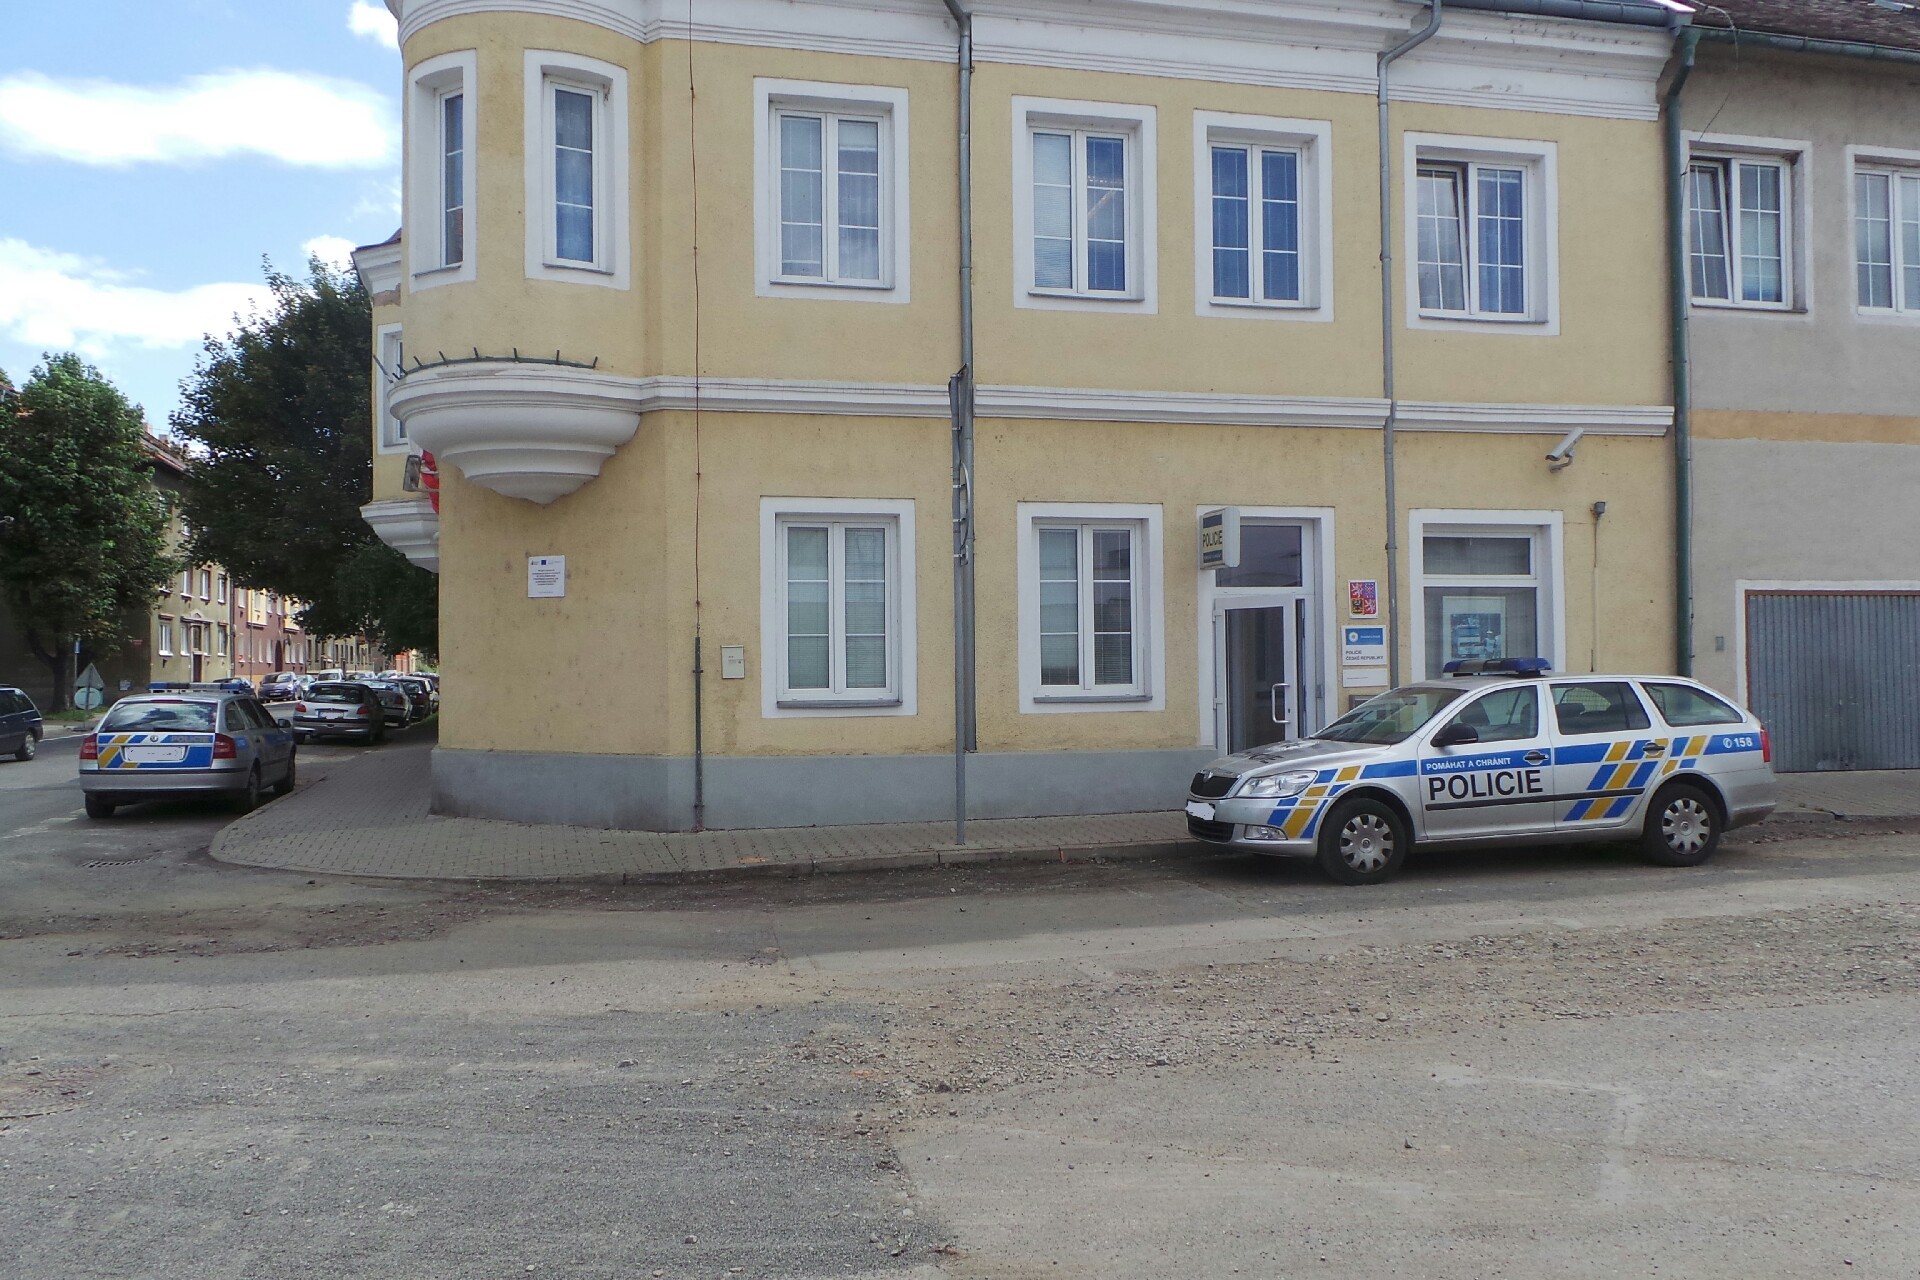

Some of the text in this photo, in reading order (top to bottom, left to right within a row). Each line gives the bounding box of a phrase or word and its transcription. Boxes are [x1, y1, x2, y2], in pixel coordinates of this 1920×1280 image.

[1202, 530, 1223, 547] POLICIE
[1733, 736, 1753, 747] 158
[1426, 757, 1511, 771] POMÁHAT A CHRÁNIT
[1428, 769, 1543, 801] POLICIE
